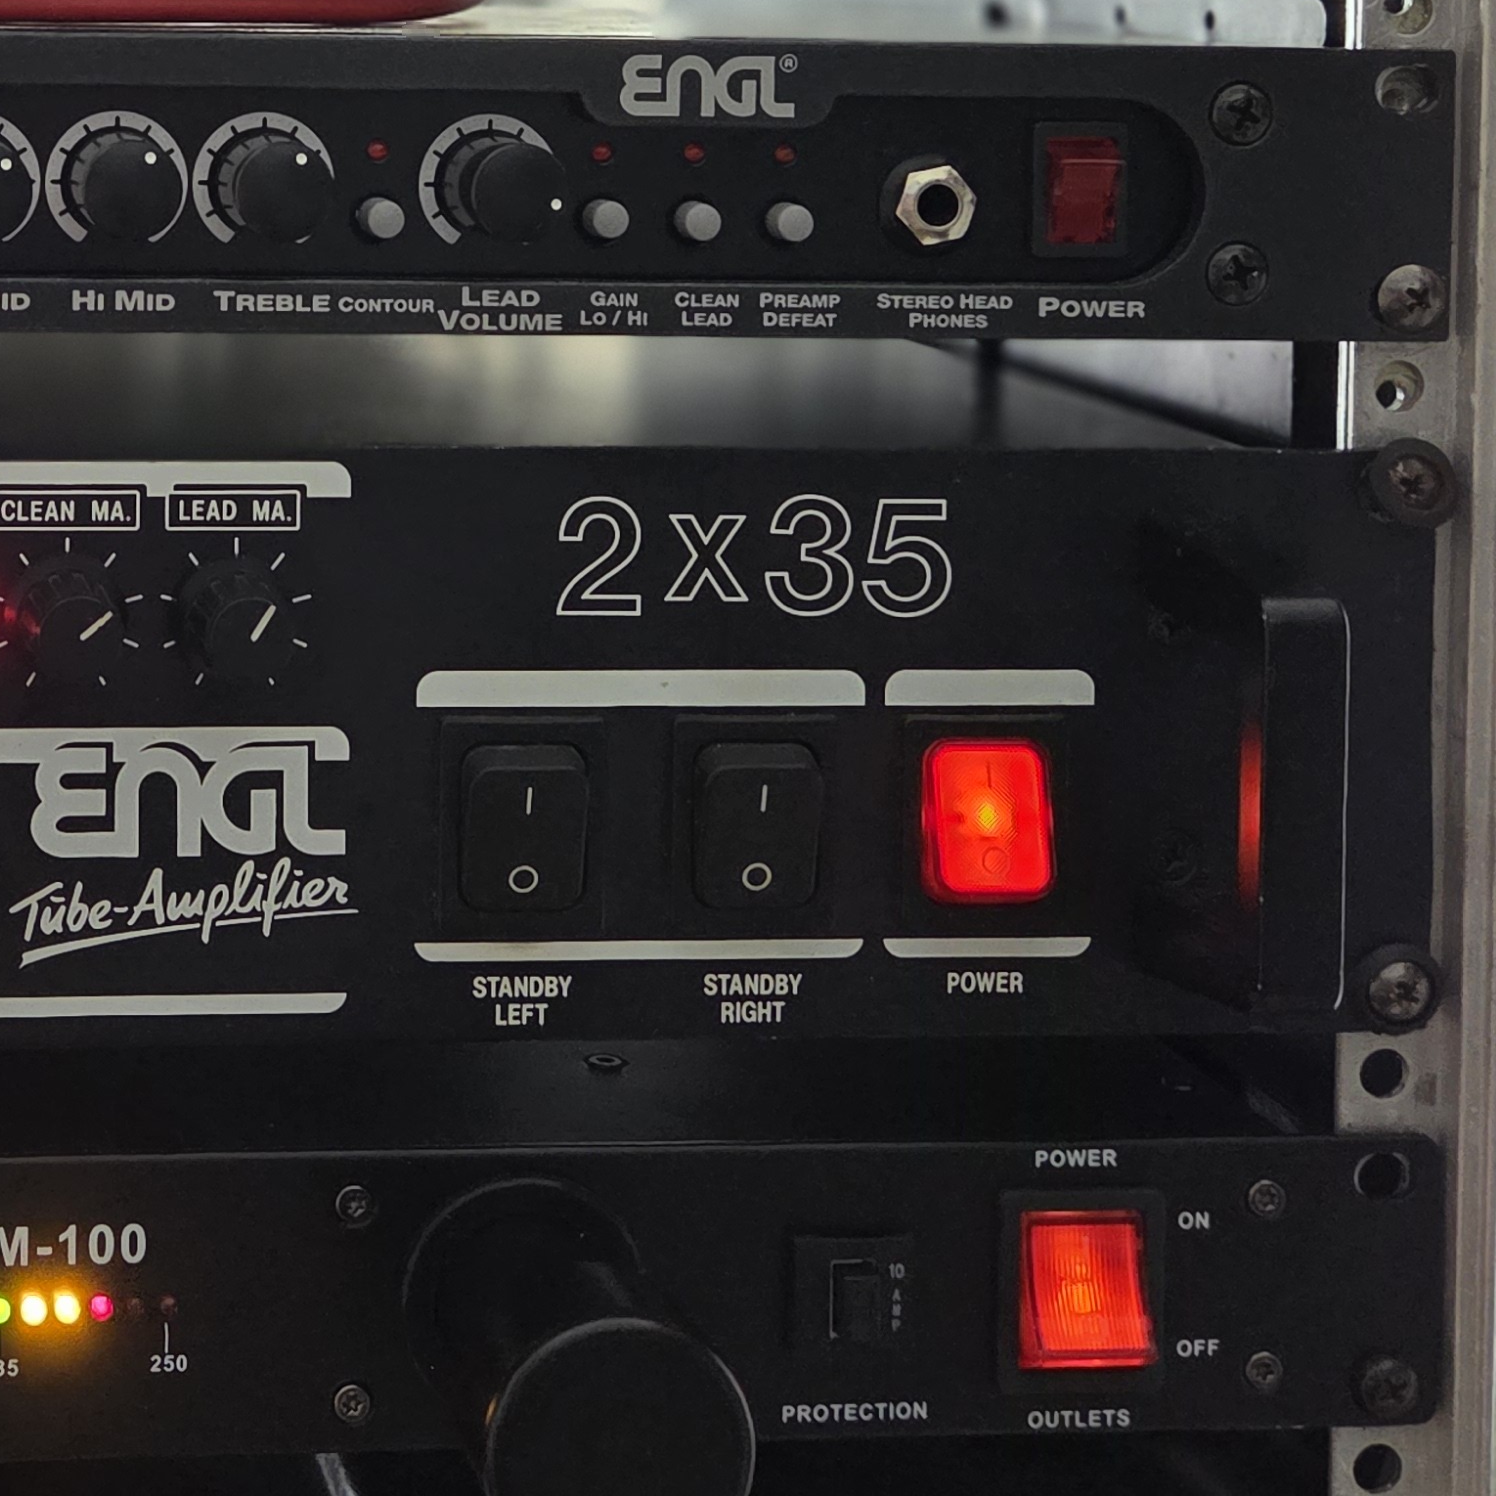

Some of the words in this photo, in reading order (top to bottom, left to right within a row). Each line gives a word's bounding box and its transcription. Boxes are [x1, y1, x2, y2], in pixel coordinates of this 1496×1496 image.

[759, 292, 841, 308] PREAMP
[762, 313, 837, 328] DEFEAT
[908, 313, 988, 329] PHONES
[1, 501, 75, 522] CLEAN
[91, 502, 131, 522] MA.
[178, 501, 237, 522] LEAD
[252, 501, 291, 522] MA.
[30, 744, 346, 858] ENGL
[473, 976, 572, 999] STANDBY
[703, 974, 802, 997] STANDBY
[947, 972, 1023, 994] POWER
[495, 1003, 548, 1026] LEFT
[720, 1001, 785, 1023] RIGHT
[1034, 1148, 1117, 1168] POWER
[1178, 1212, 1210, 1230] ON
[1176, 1340, 1219, 1357] OFF
[150, 1354, 188, 1373] 250
[781, 1402, 928, 1423] PROTECTION
[1027, 1409, 1131, 1428] OUTLETS
